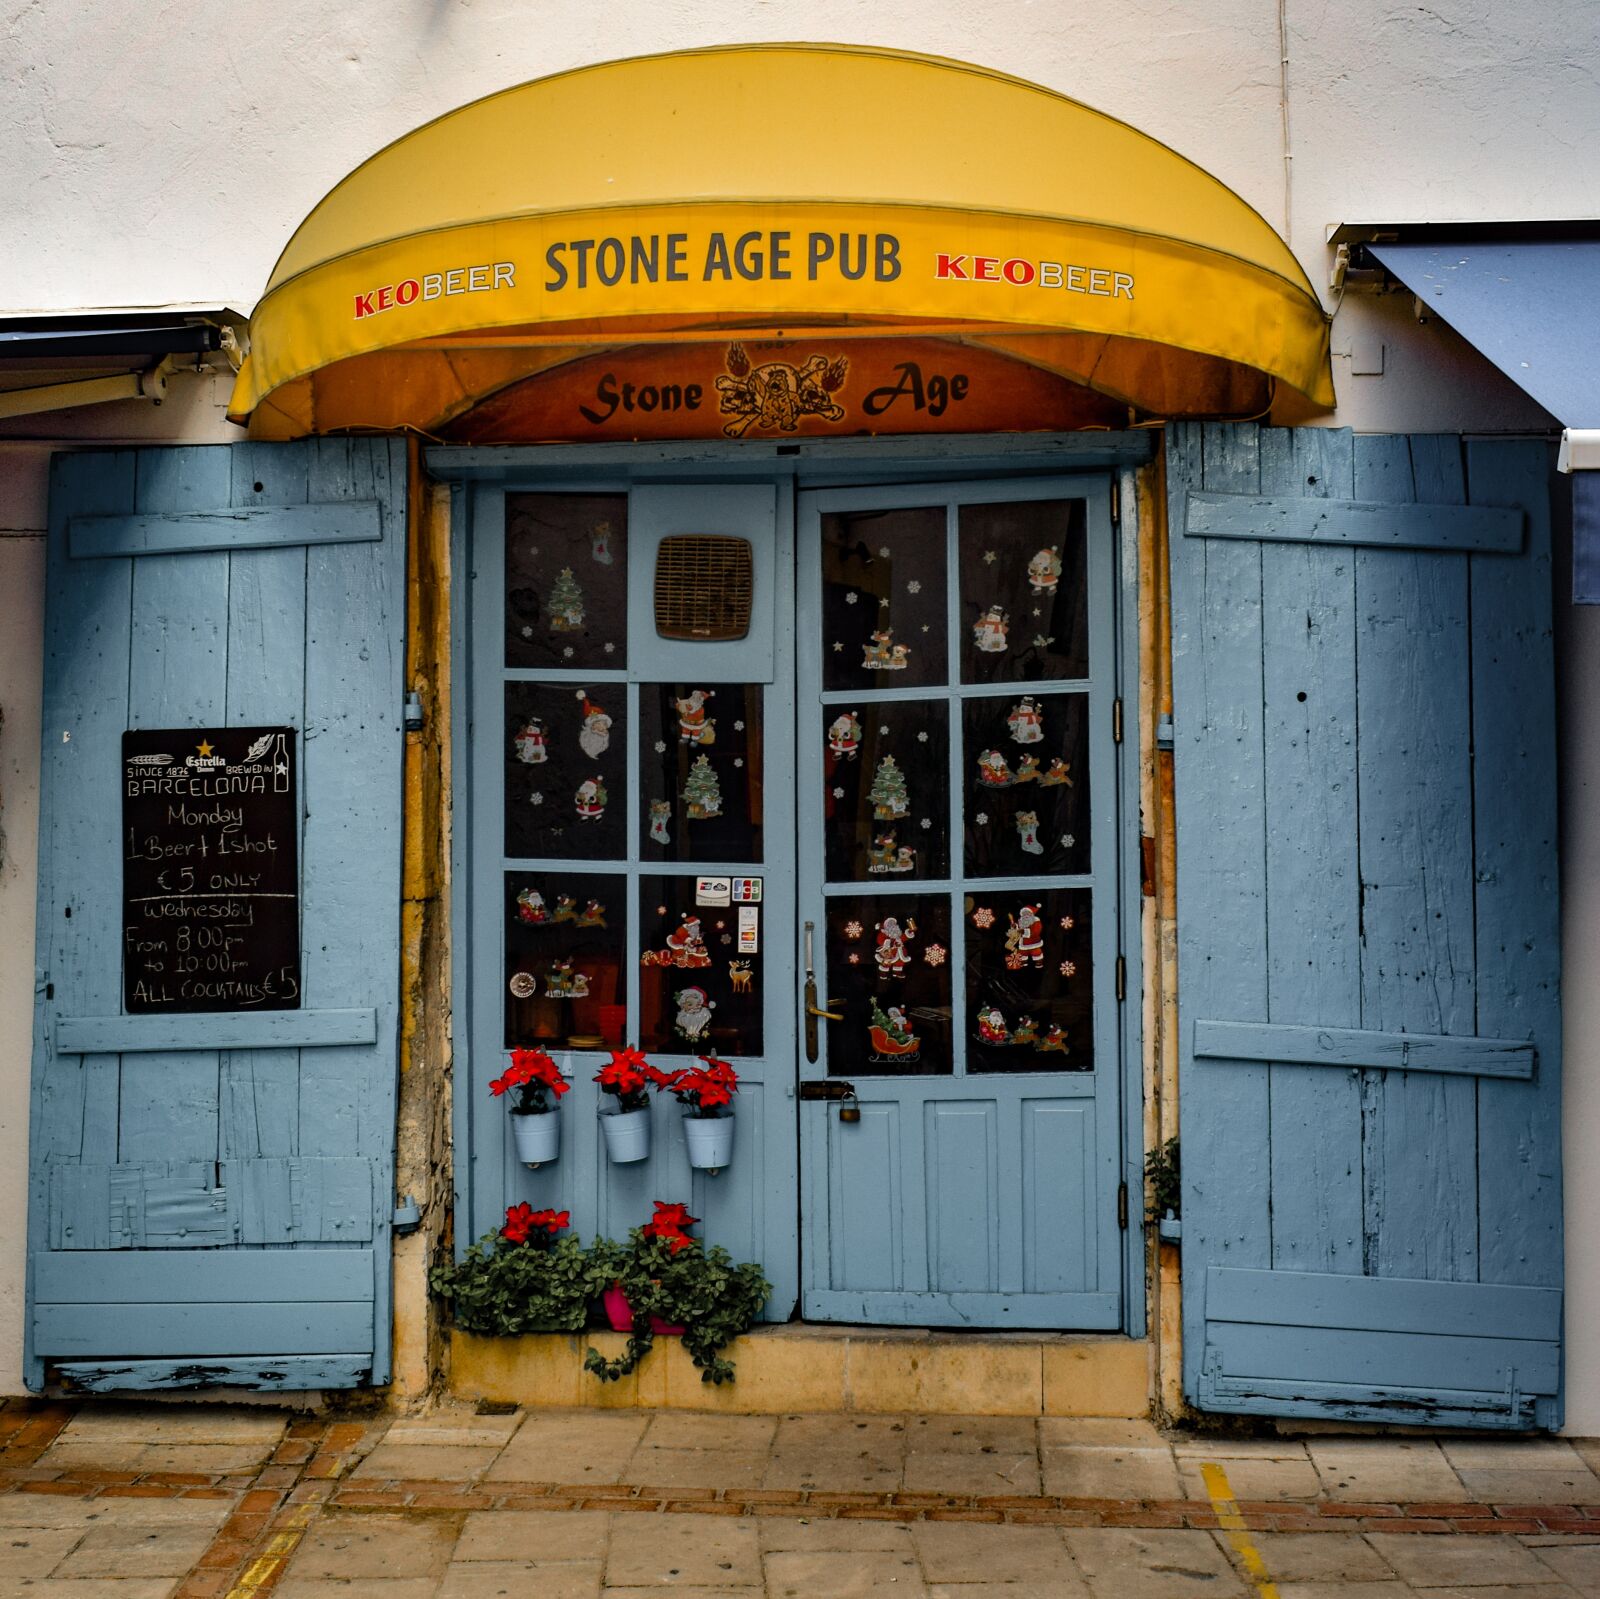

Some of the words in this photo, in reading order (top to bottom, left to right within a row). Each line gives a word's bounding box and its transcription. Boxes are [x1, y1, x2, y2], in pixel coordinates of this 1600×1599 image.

[545, 233, 688, 292] STONE
[702, 231, 791, 282] AGE
[808, 232, 902, 283] PUB
[579, 373, 703, 425] Stone
[862, 361, 969, 416] Age
[185, 756, 226, 767] Estrella
[226, 765, 262, 775] BREWED
[166, 766, 189, 777] 1876
[128, 776, 265, 797] BARCELONA
[168, 803, 243, 833] Monday
[210, 873, 261, 889] ONLY
[734, 886, 759, 894] JCB
[127, 926, 168, 954] From
[144, 960, 164, 972] to
[133, 980, 175, 1003] ALL
